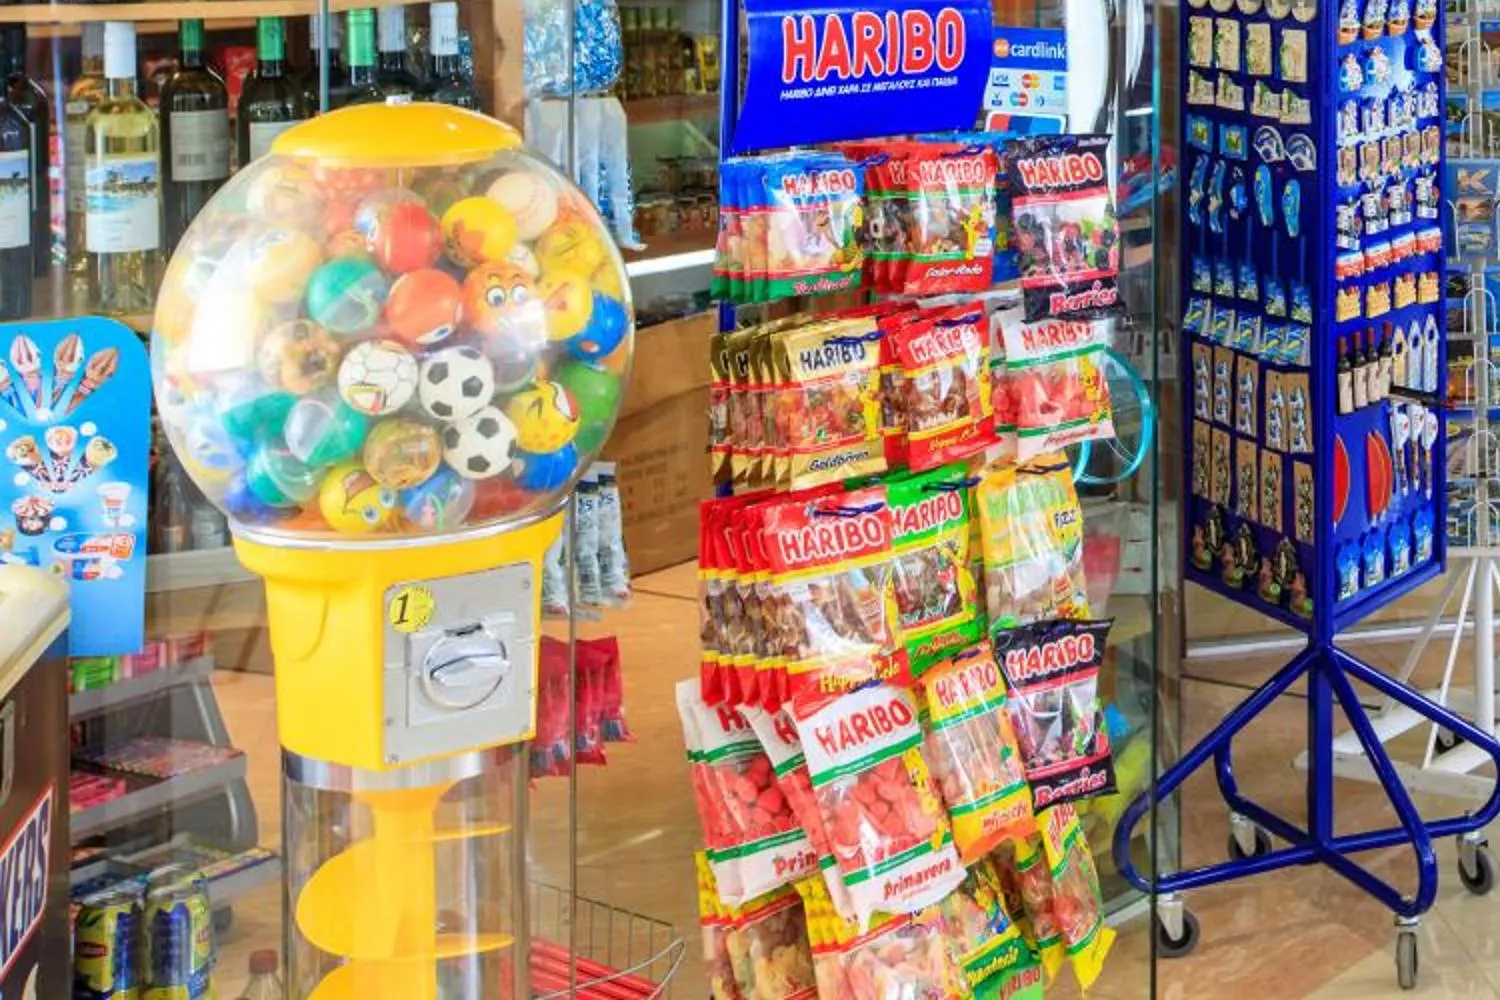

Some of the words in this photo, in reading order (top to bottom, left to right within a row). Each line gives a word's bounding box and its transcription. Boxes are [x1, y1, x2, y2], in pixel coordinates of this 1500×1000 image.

[782, 7, 966, 83] HARIBO
[1011, 41, 1065, 59] cardlink
[782, 170, 856, 195] HARIBO
[920, 159, 987, 185] HARIBO
[1017, 152, 1103, 188] HARIBO
[1050, 279, 1118, 315] Berries
[1021, 319, 1094, 351] HARIBO
[800, 344, 866, 371] HARIBO
[891, 489, 965, 538] HARIBO
[778, 514, 885, 565] HARIBO
[393, 592, 409, 626] 1
[1004, 632, 1095, 682] HARIBO
[814, 699, 913, 756] HARIBO
[1034, 765, 1107, 807] Berries
[883, 856, 951, 900] Primavera
